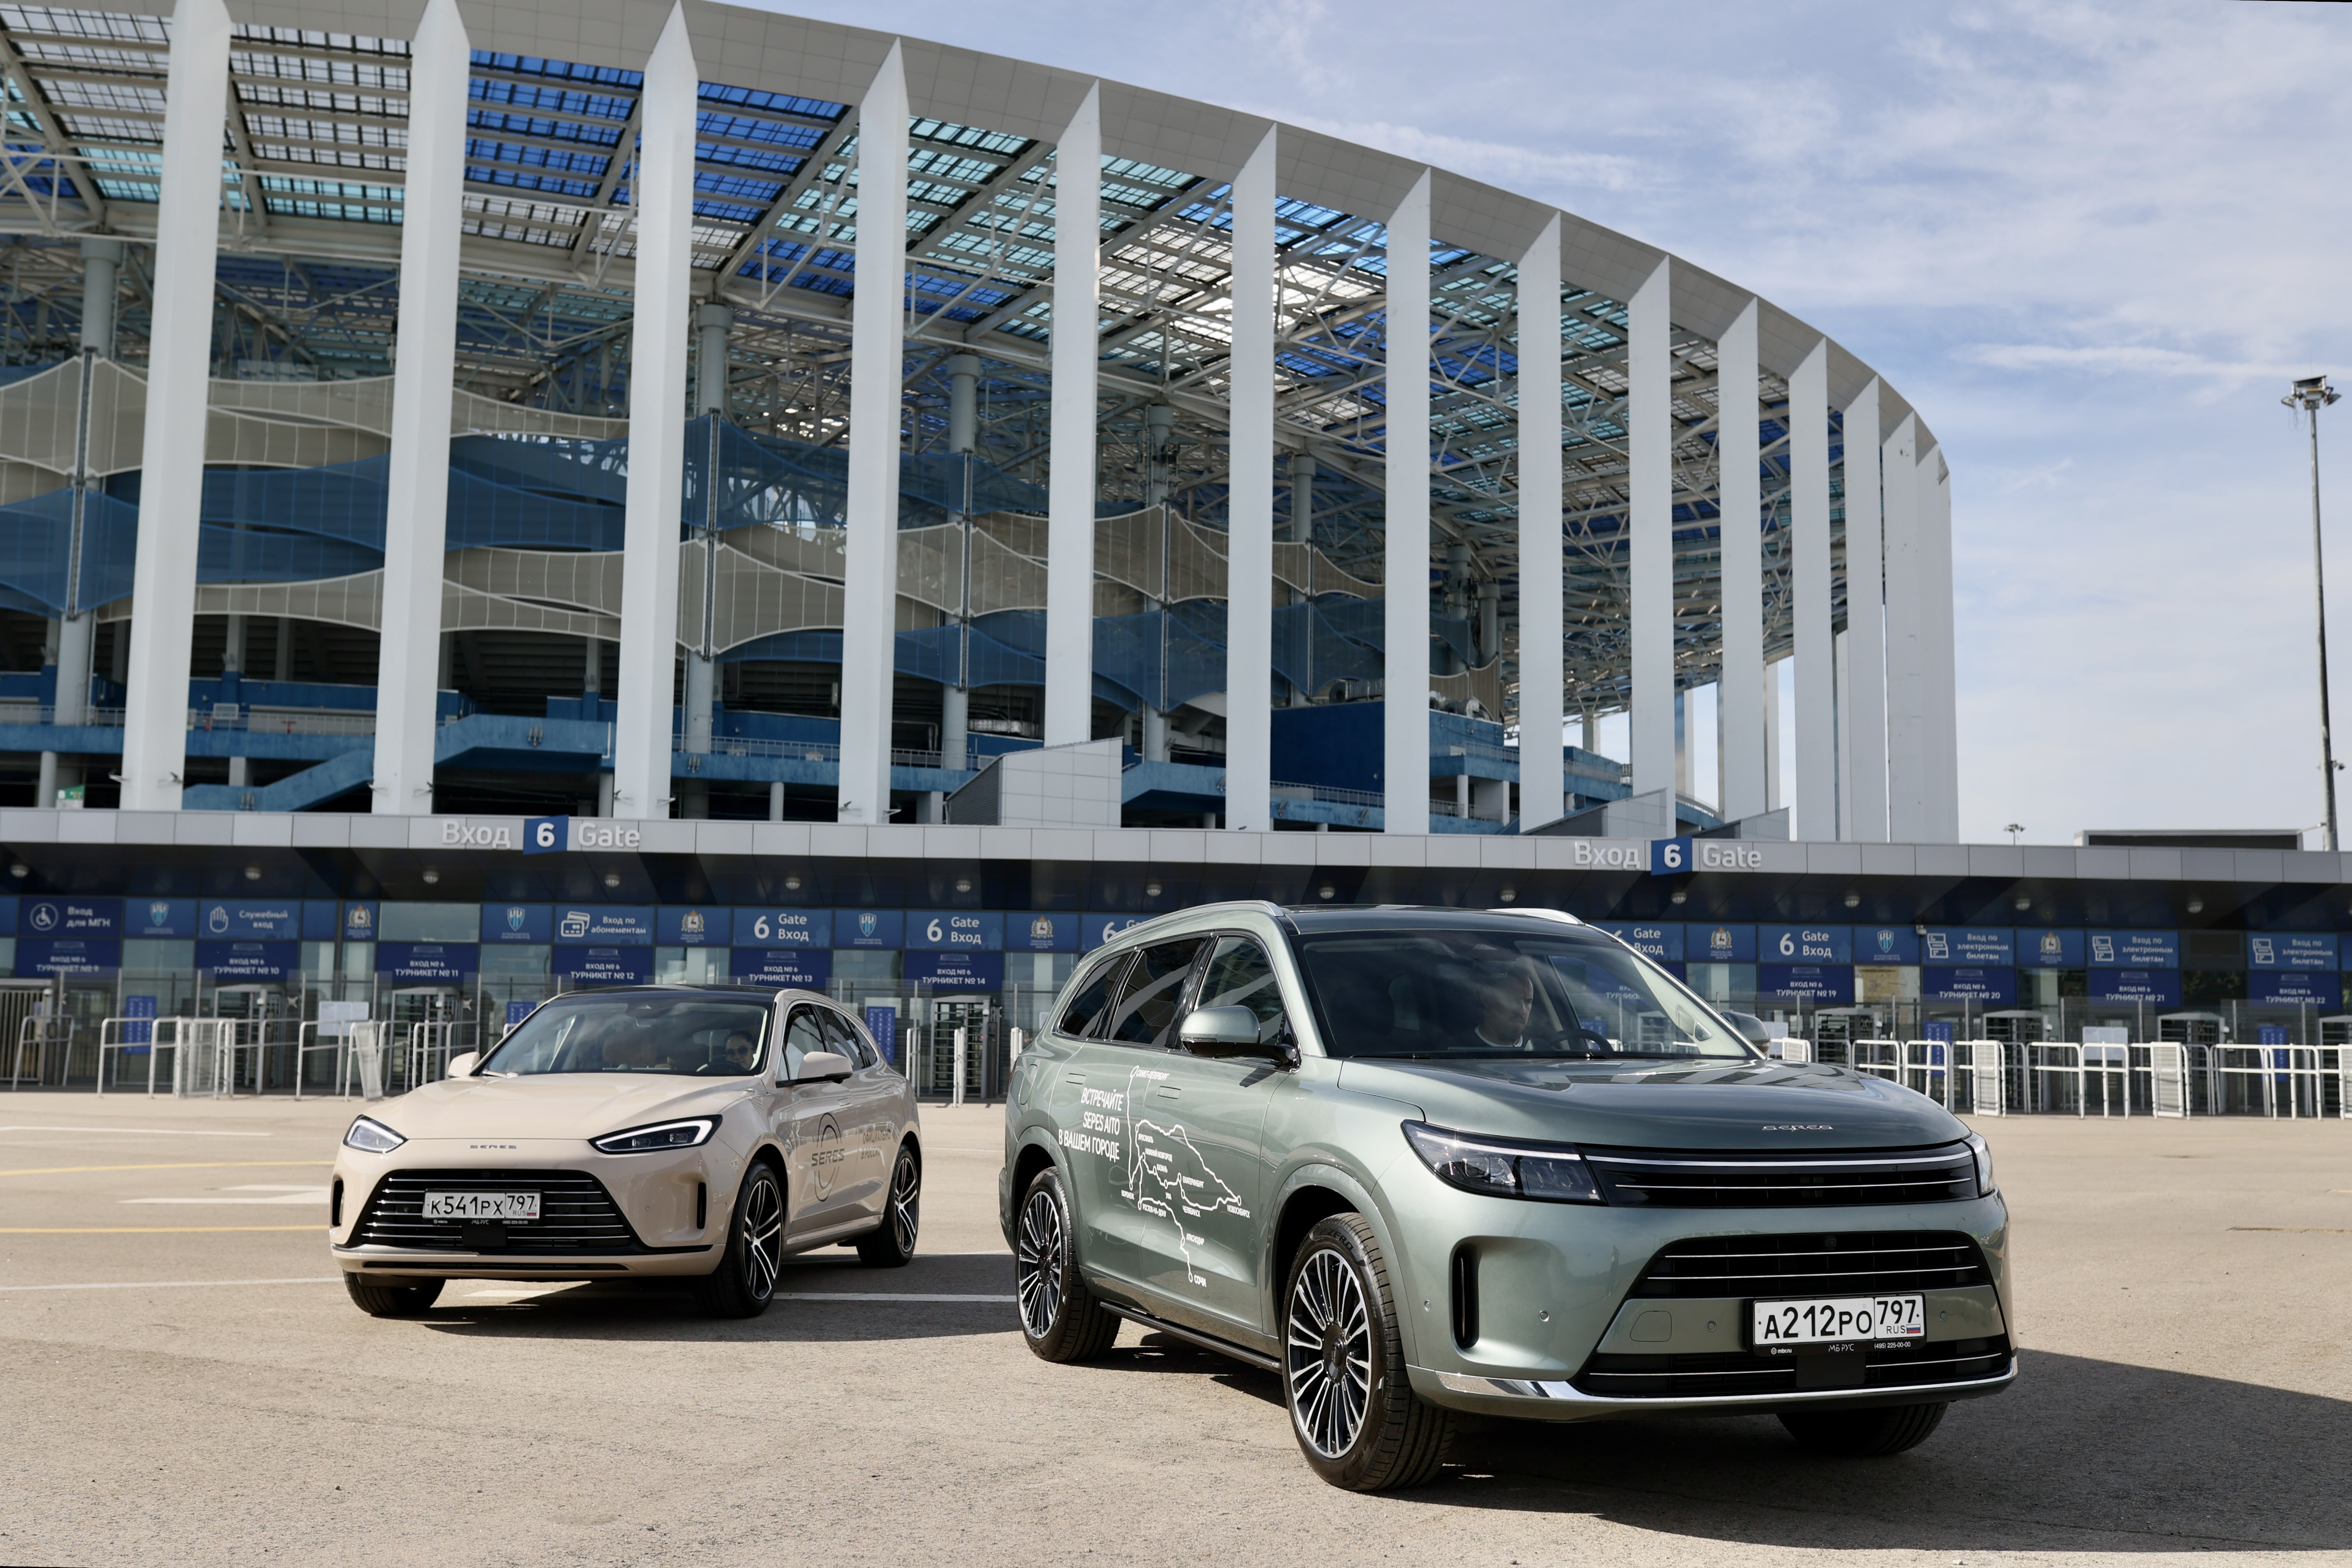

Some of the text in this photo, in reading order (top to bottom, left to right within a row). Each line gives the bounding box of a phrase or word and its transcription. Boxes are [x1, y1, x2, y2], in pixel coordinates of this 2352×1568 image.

[442, 819, 640, 849] Вход 6 Gate
[1574, 842, 1761, 870] Вход 6 Gate
[68, 906, 93, 916] Вход
[239, 910, 288, 919] Служебный
[603, 916, 623, 925] Вход
[779, 914, 807, 924] Gate
[951, 917, 979, 927] Gate
[591, 925, 646, 934] абонементам
[754, 916, 809, 941] 6 Вход
[927, 919, 981, 944] 6 Вход
[1634, 928, 1661, 938] Gate
[1802, 931, 1829, 941] Gate
[1968, 933, 1986, 942] Вход
[2133, 936, 2151, 945] Вход
[1634, 943, 1664, 955] Вход
[1780, 933, 1832, 958] 6 Вход
[1958, 944, 2008, 953] электронным
[2283, 949, 2333, 958] электронным
[1776, 990, 1815, 998] ТУРНИКЕТ
[2266, 996, 2305, 1005] ТУРНИКЕТ
[1136, 1069, 1170, 1081] САНКТ-ПЕТЕРБУРГ
[1081, 1087, 1124, 1111] ВСТРЕЧАЙТЕ
[1104, 1116, 1120, 1136] AITO
[863, 1129, 891, 1144] ОФИЦИАЛЬНО
[1059, 1129, 1120, 1162] В ВАШЕМ ГОРОДЕ
[811, 1148, 844, 1166] SERES
[1145, 1148, 1172, 1162] НИЖНИЙ НОВГОРОД
[1157, 1163, 1168, 1173] КАЗАНЬ
[1182, 1176, 1204, 1188] ЕКАТЕРИНБУРГ
[1121, 1190, 1135, 1200] ВОРОНЕЖ
[507, 1195, 535, 1210] 797
[1143, 1203, 1166, 1217] РОСТОВ-НА-ДОНУ
[1182, 1205, 1201, 1217] ЧЕЛЯБИНСК
[1227, 1204, 1250, 1218] НОВОСИБИРСК
[1186, 1233, 1205, 1245] КРАСНОДАР
[1194, 1274, 1206, 1287] СОЧИ
[1877, 1300, 1916, 1324] 797
[1886, 1325, 1906, 1334] RUS
